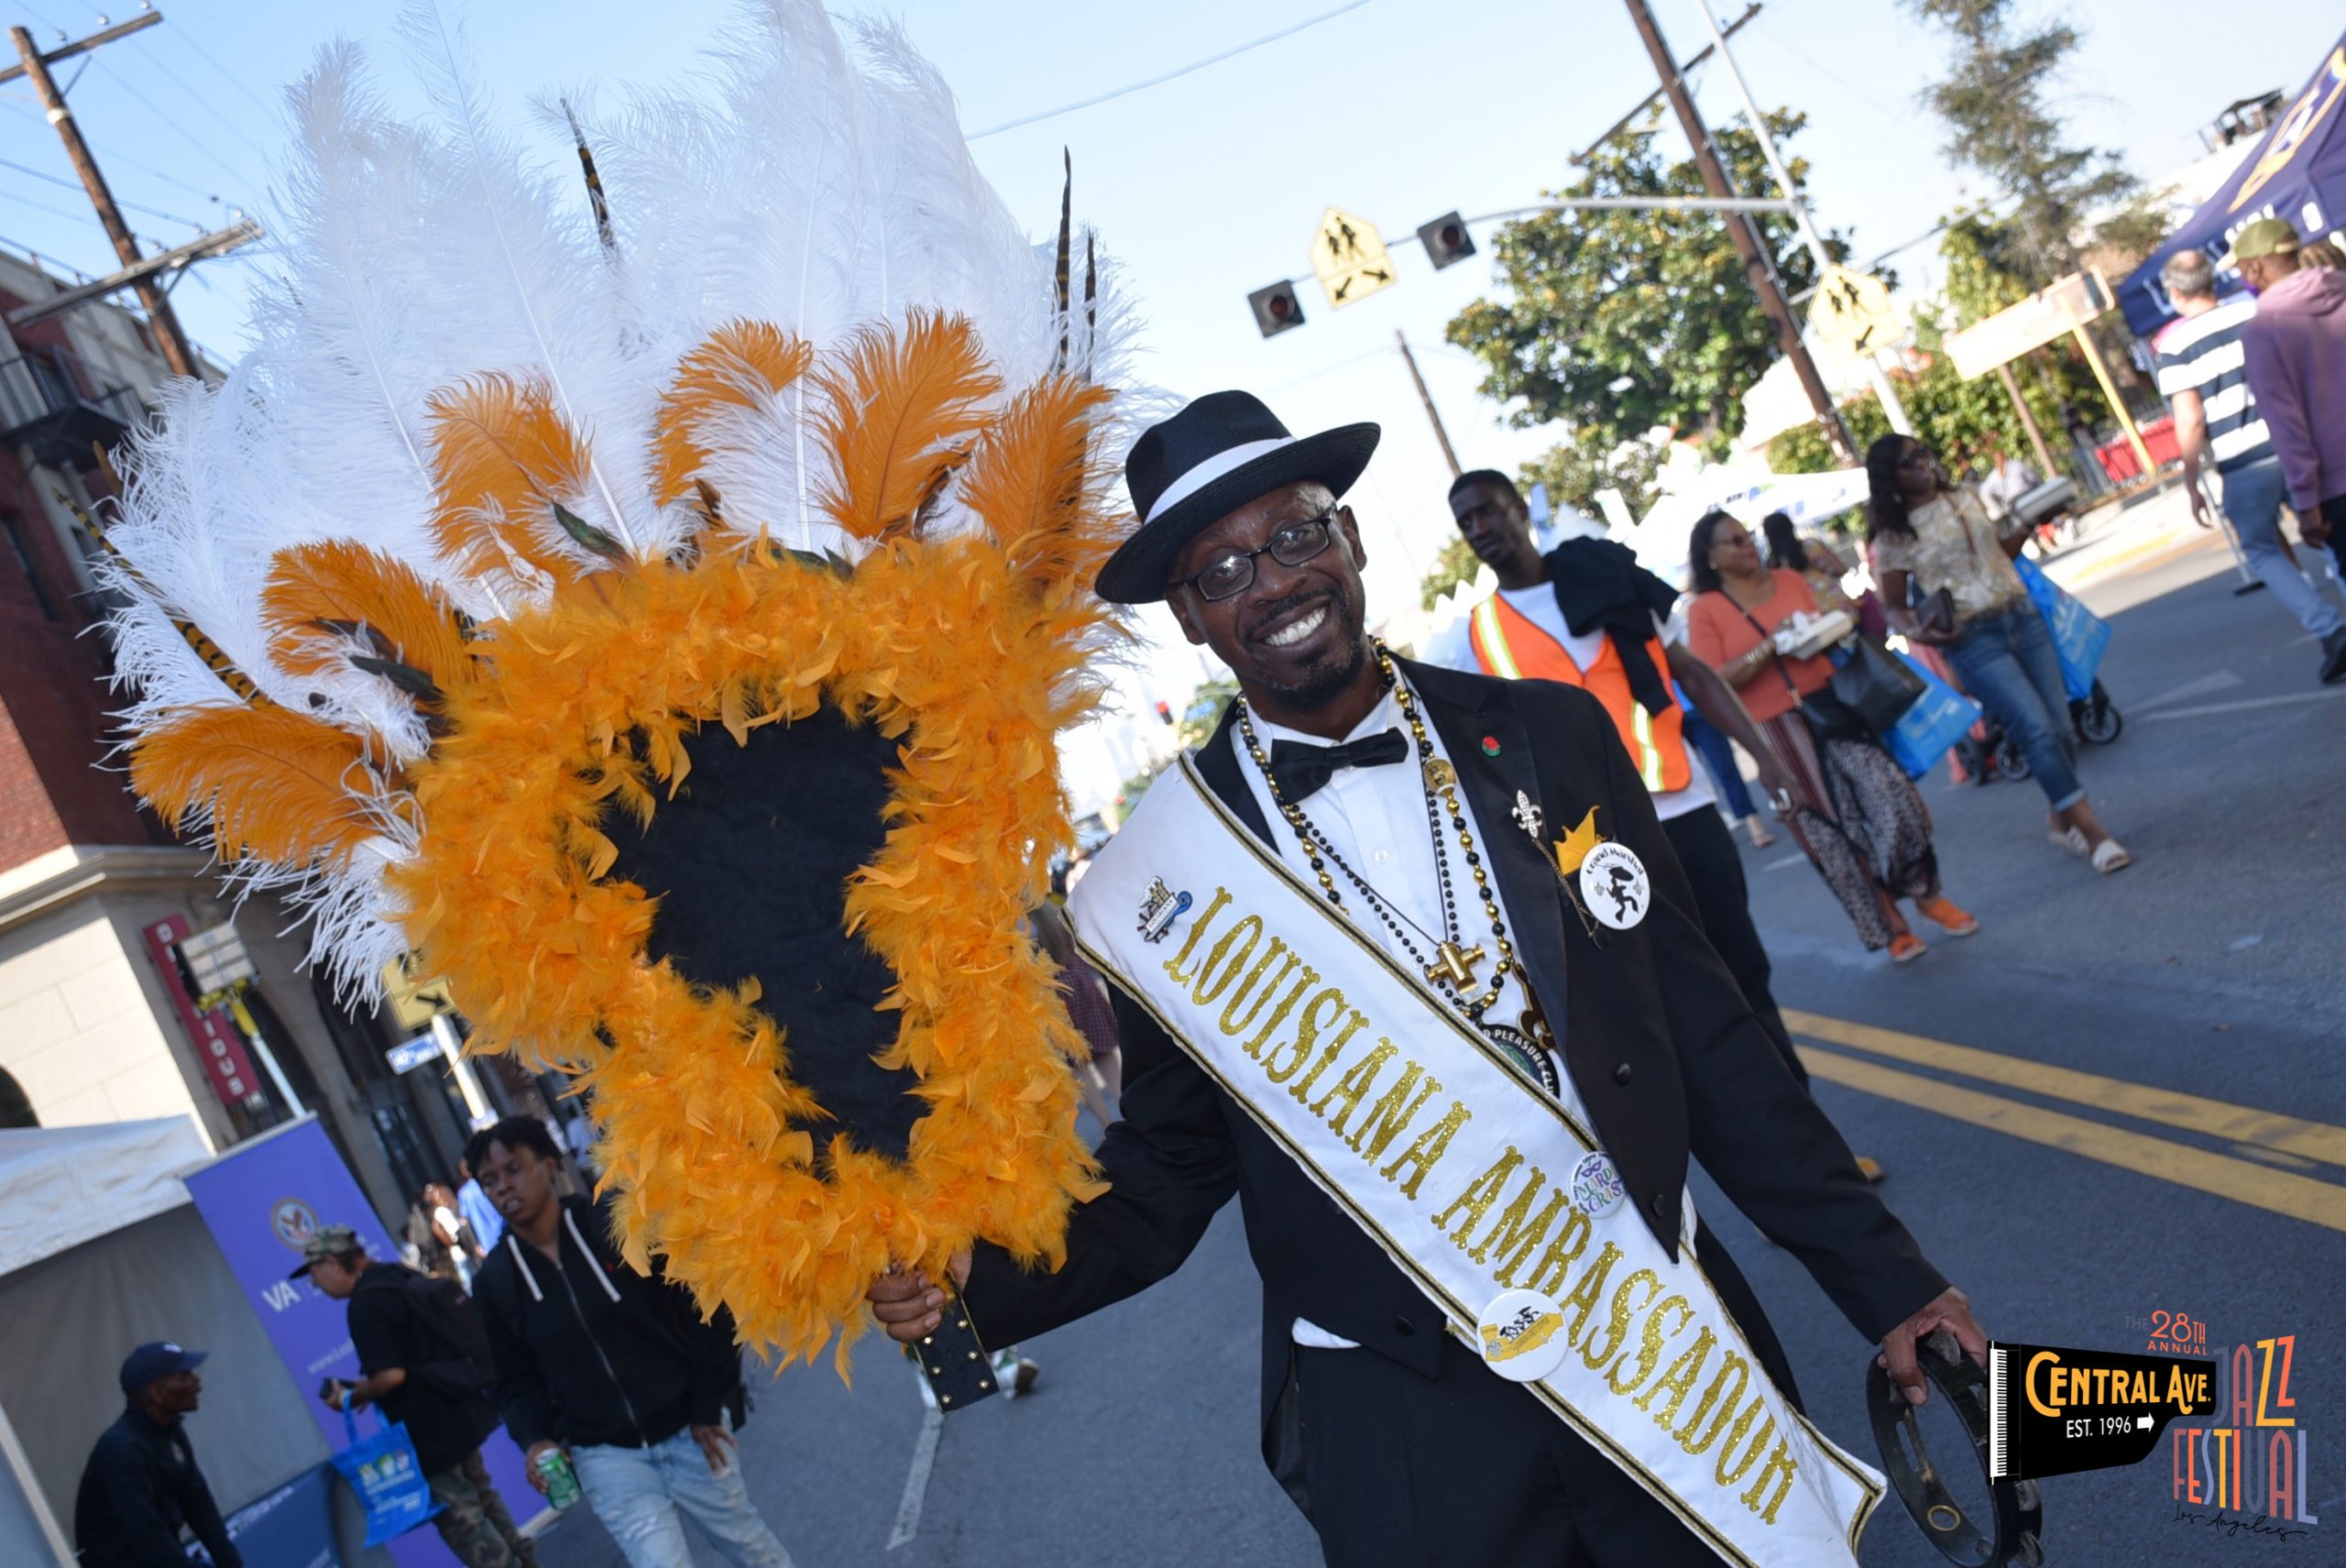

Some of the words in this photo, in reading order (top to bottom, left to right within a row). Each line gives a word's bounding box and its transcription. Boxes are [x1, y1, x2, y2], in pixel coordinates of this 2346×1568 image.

[1494, 1029, 1547, 1069] PLEASURE
[1162, 886, 1472, 1201] LOUISIANA
[1431, 1146, 1798, 1525] AMBASSADOR
[262, 1280, 301, 1312] VA
